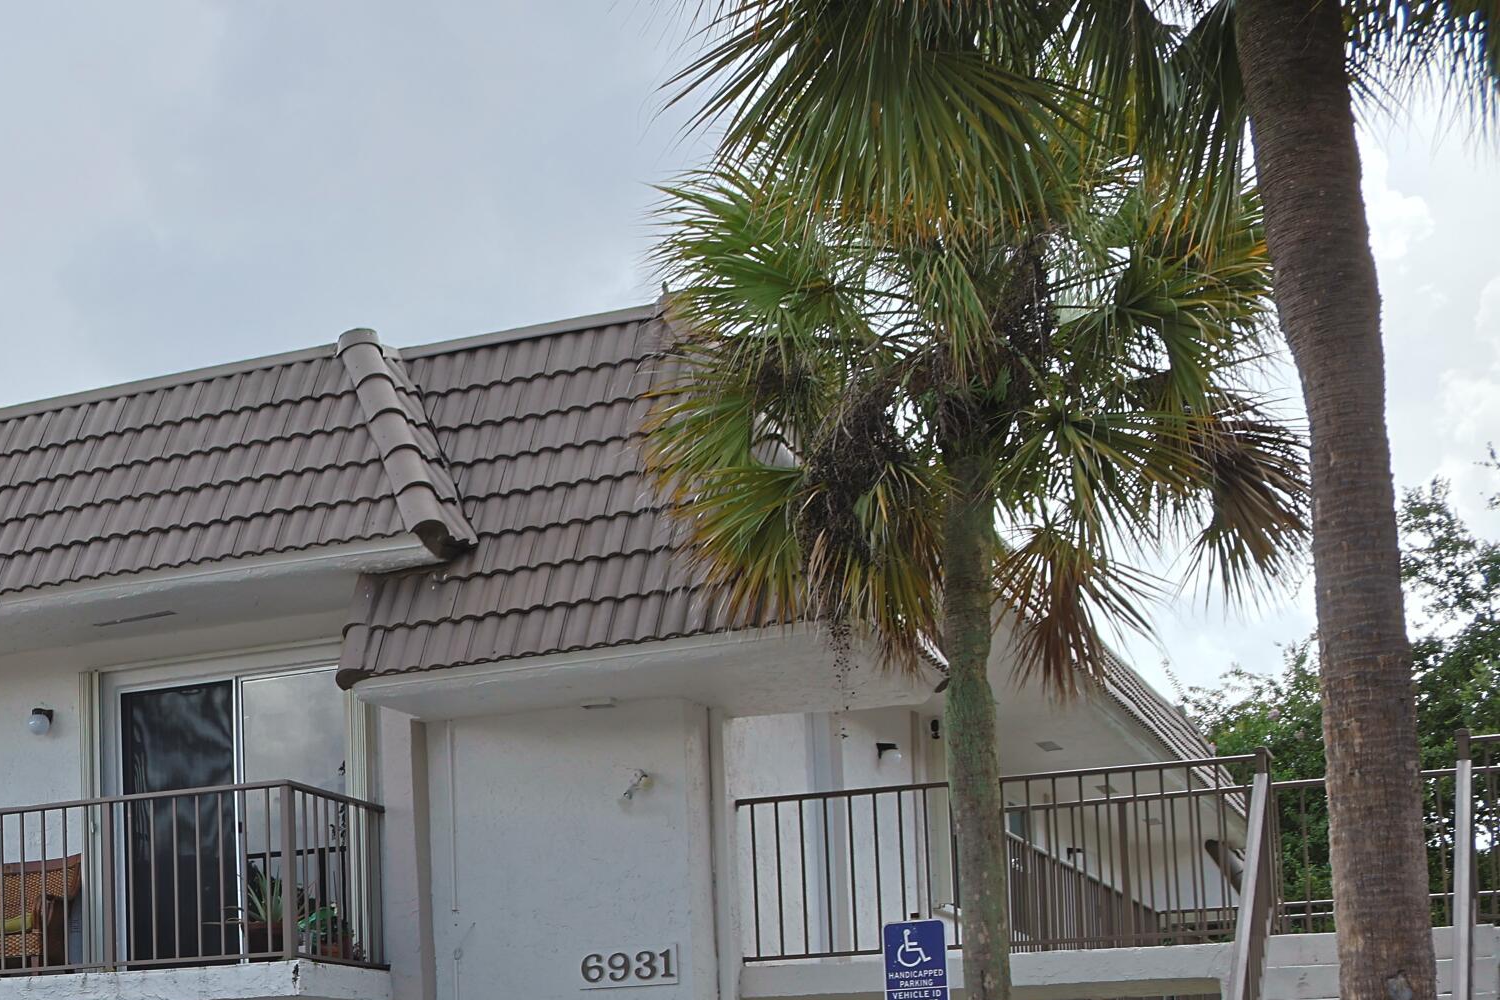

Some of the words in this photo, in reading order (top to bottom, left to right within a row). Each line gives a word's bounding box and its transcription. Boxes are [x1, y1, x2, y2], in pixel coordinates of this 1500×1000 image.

[581, 949, 675, 983] 6931
[888, 969, 944, 979] HANDICAPPED
[899, 979, 934, 988] PARKING
[892, 990, 930, 1000] VEHICLE
[932, 989, 942, 997] ID
